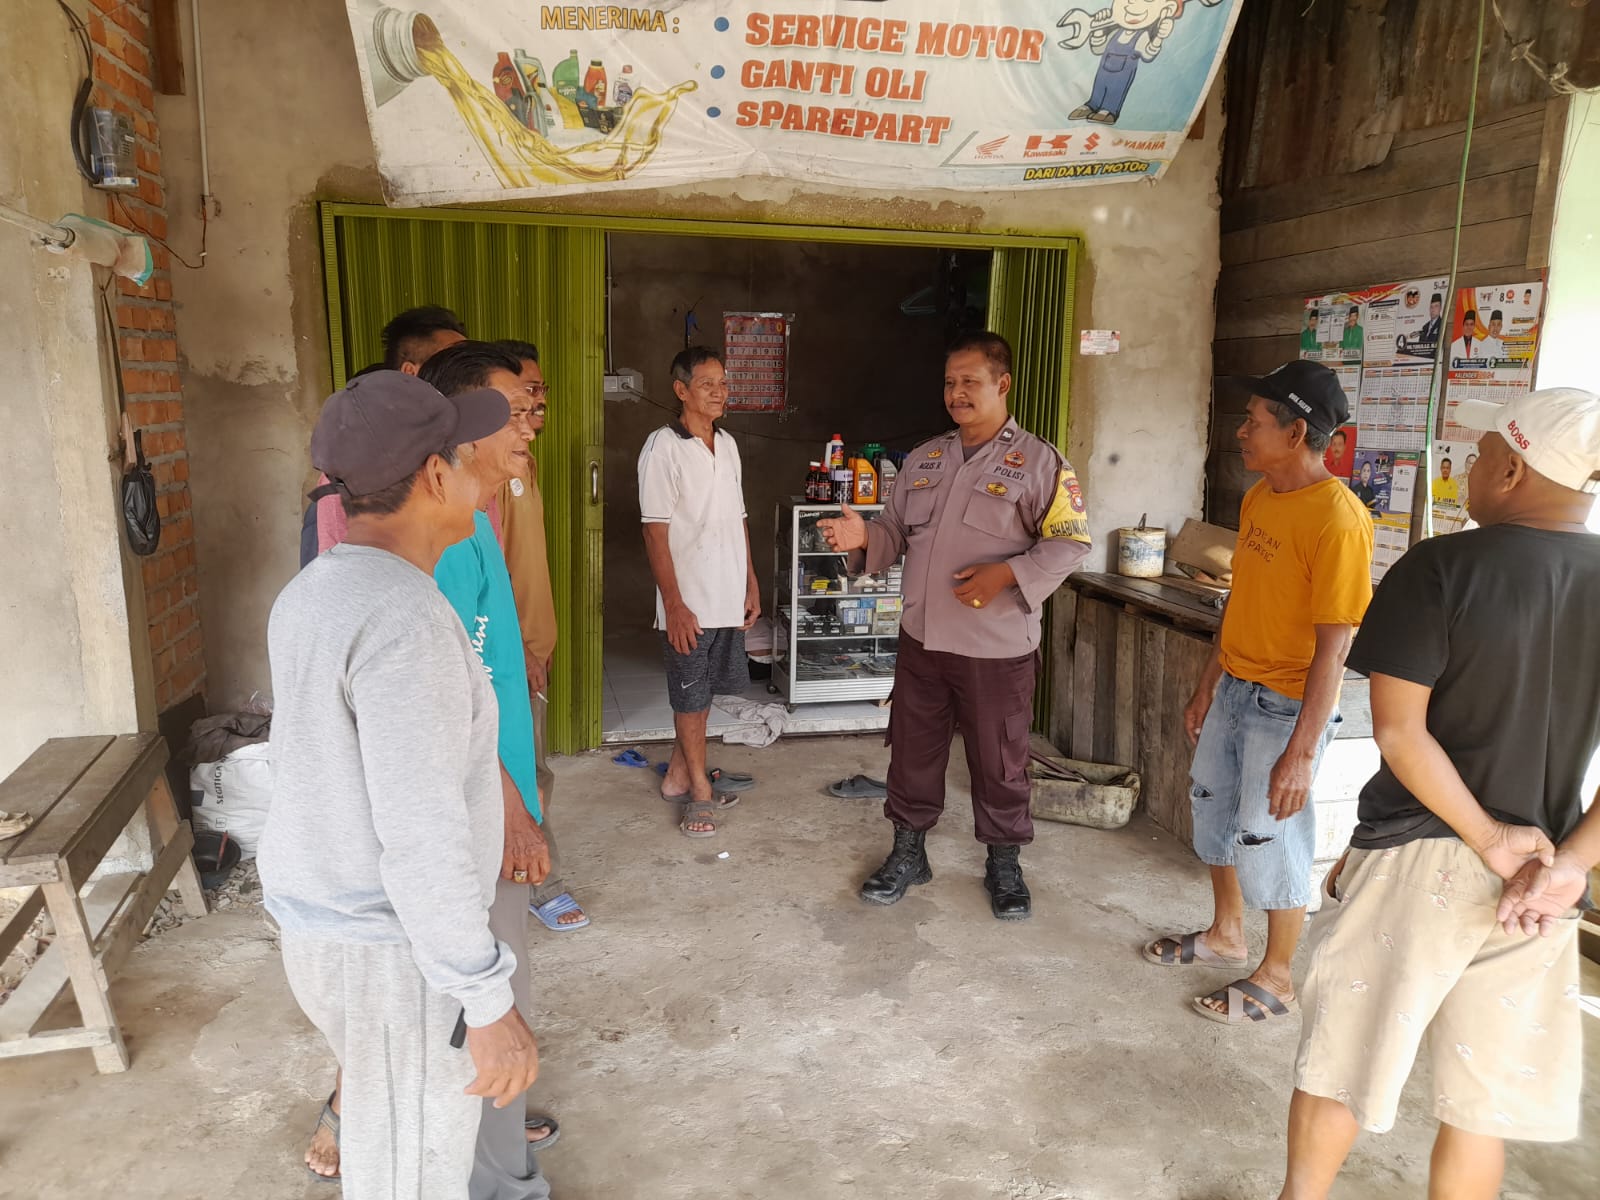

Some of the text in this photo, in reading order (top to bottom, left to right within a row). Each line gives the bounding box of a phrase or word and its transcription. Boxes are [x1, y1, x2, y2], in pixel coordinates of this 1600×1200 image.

[541, 5, 667, 32] MENERIMA
[745, 12, 1044, 61] SERVICE MOTOR
[741, 59, 927, 100] GANTI OLI
[736, 101, 950, 144] SPAREPART
[1023, 150, 1067, 158] Kawasaki
[1124, 140, 1166, 151] YAMAHA
[1024, 161, 1149, 180] DARI DAYAT MOTOR
[1507, 419, 1530, 450] BOSS
[993, 466, 1025, 481] POLISI
[214, 765, 224, 805] SEGITIGA
